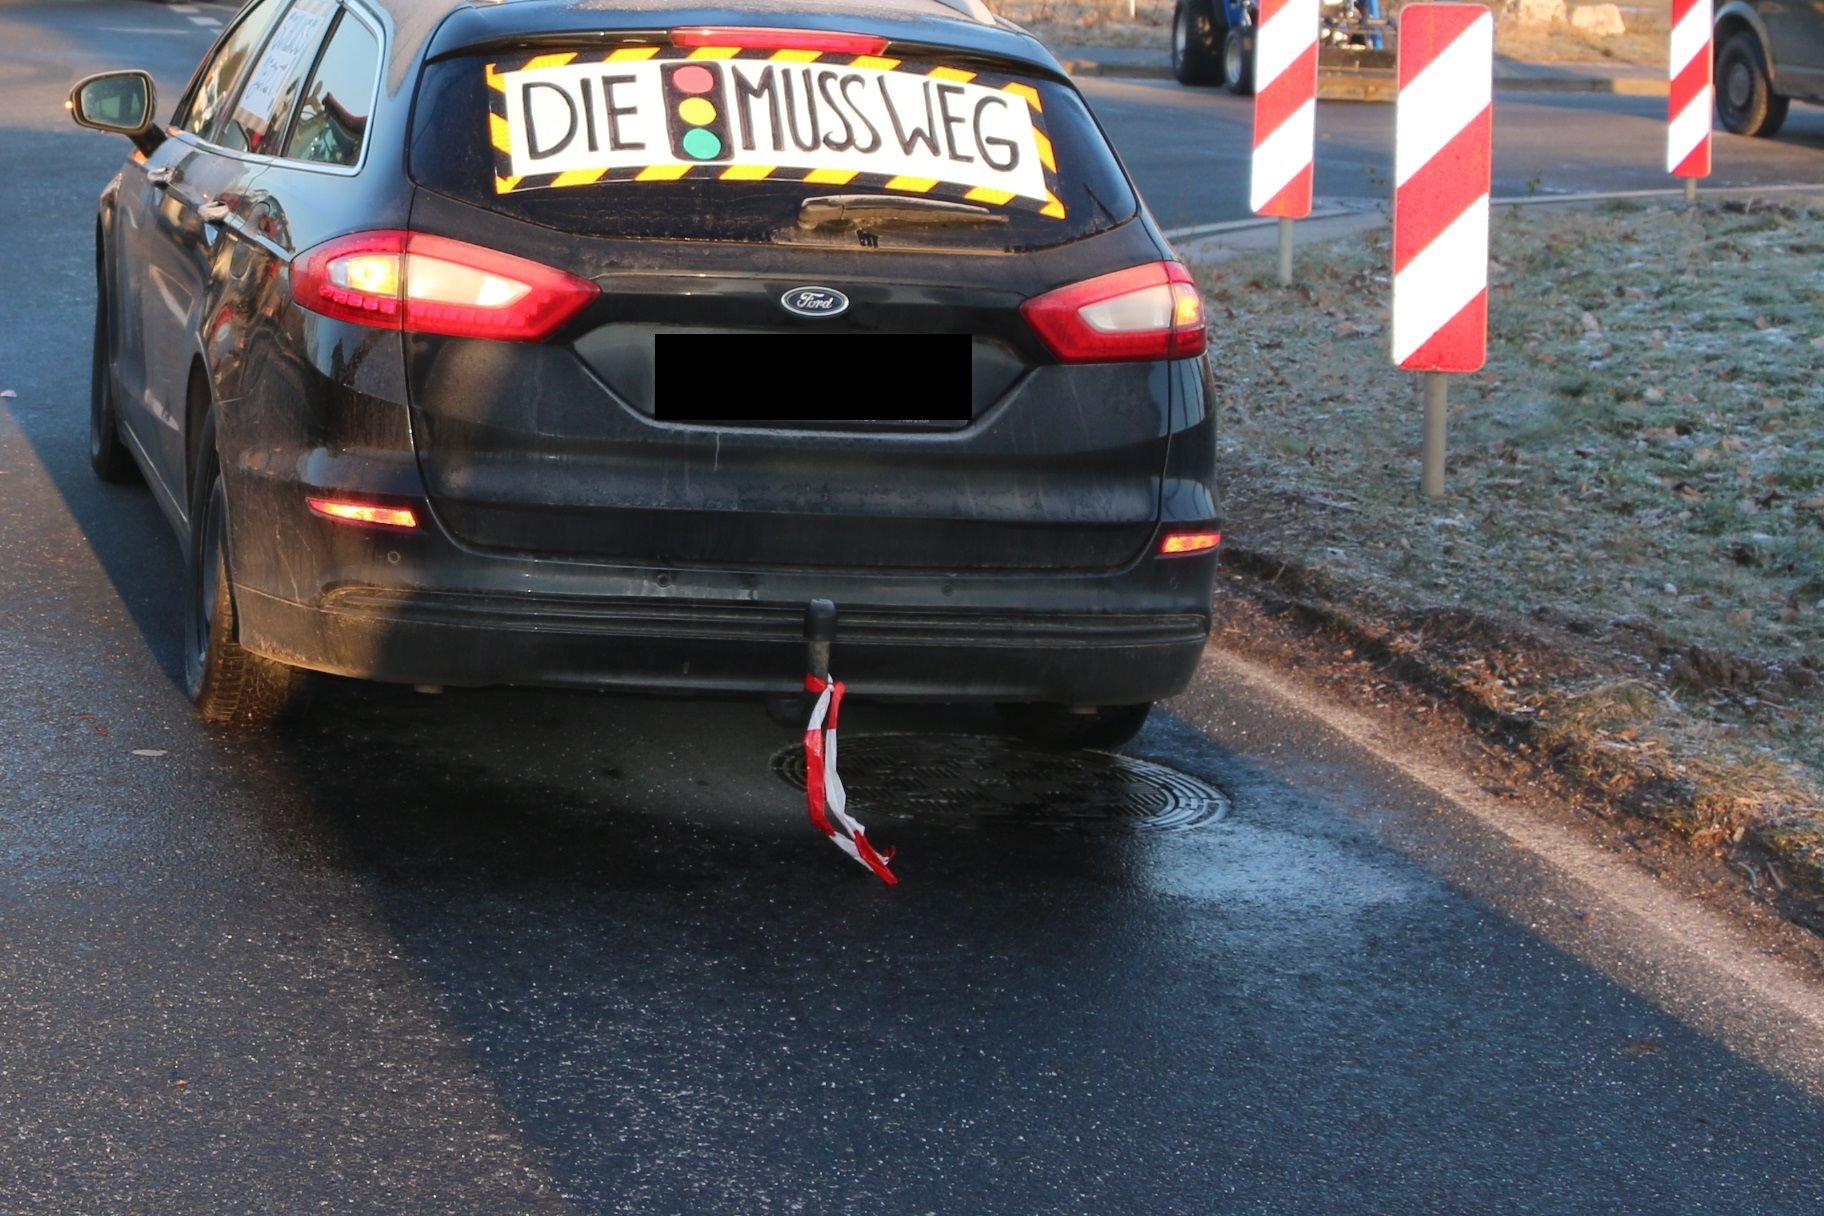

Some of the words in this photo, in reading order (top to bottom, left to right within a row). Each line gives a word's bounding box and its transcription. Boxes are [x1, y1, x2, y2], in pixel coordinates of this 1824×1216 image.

[521, 74, 646, 161] DIE
[731, 64, 882, 154] MUSS
[877, 75, 1020, 173] WEG
[796, 292, 834, 309] Ford
